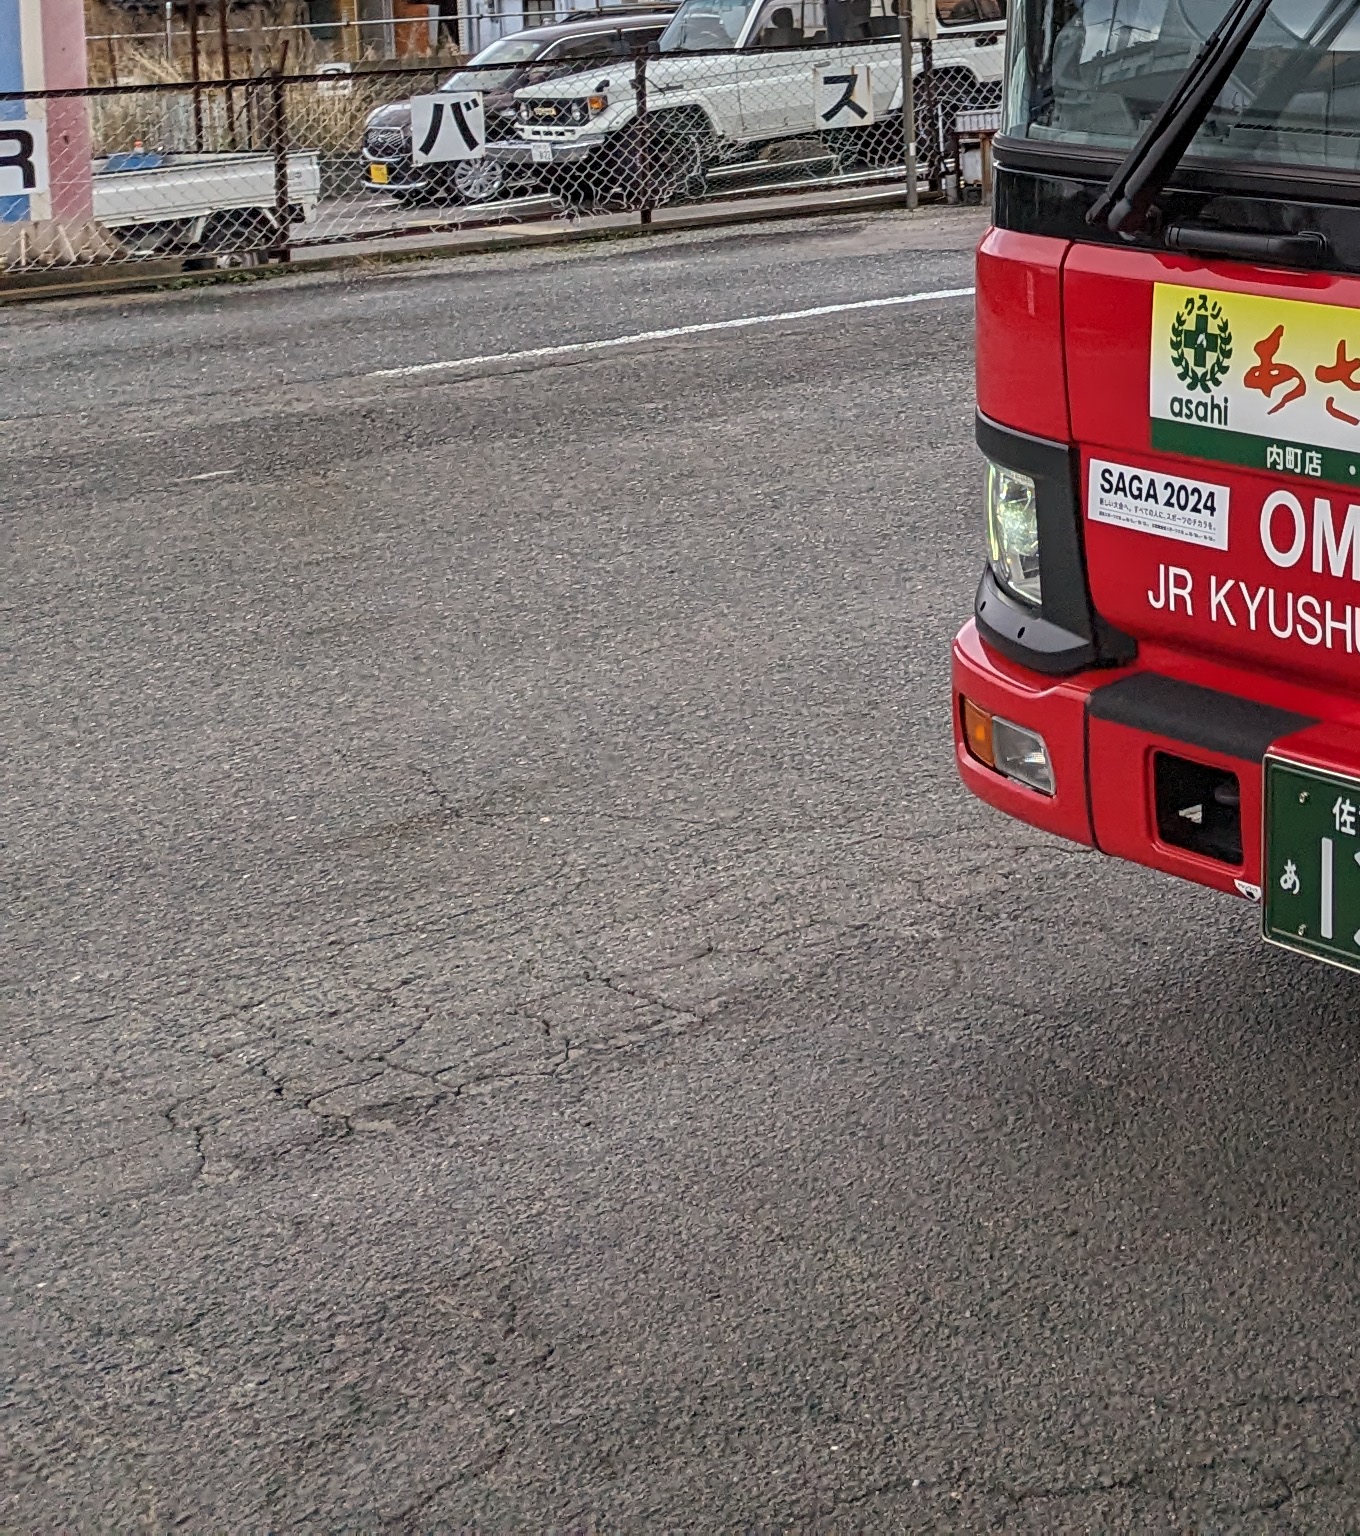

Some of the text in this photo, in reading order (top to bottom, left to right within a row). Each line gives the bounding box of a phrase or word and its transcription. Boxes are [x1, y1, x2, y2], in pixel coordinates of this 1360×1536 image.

[821, 73, 868, 122] ス
[1184, 294, 1222, 319] クスリ
[1170, 395, 1228, 426] asahi
[1266, 444, 1322, 477] 内町店
[1100, 468, 1217, 517] SAGA 2024
[1147, 563, 1193, 616] JR
[1279, 859, 1300, 894] あ
